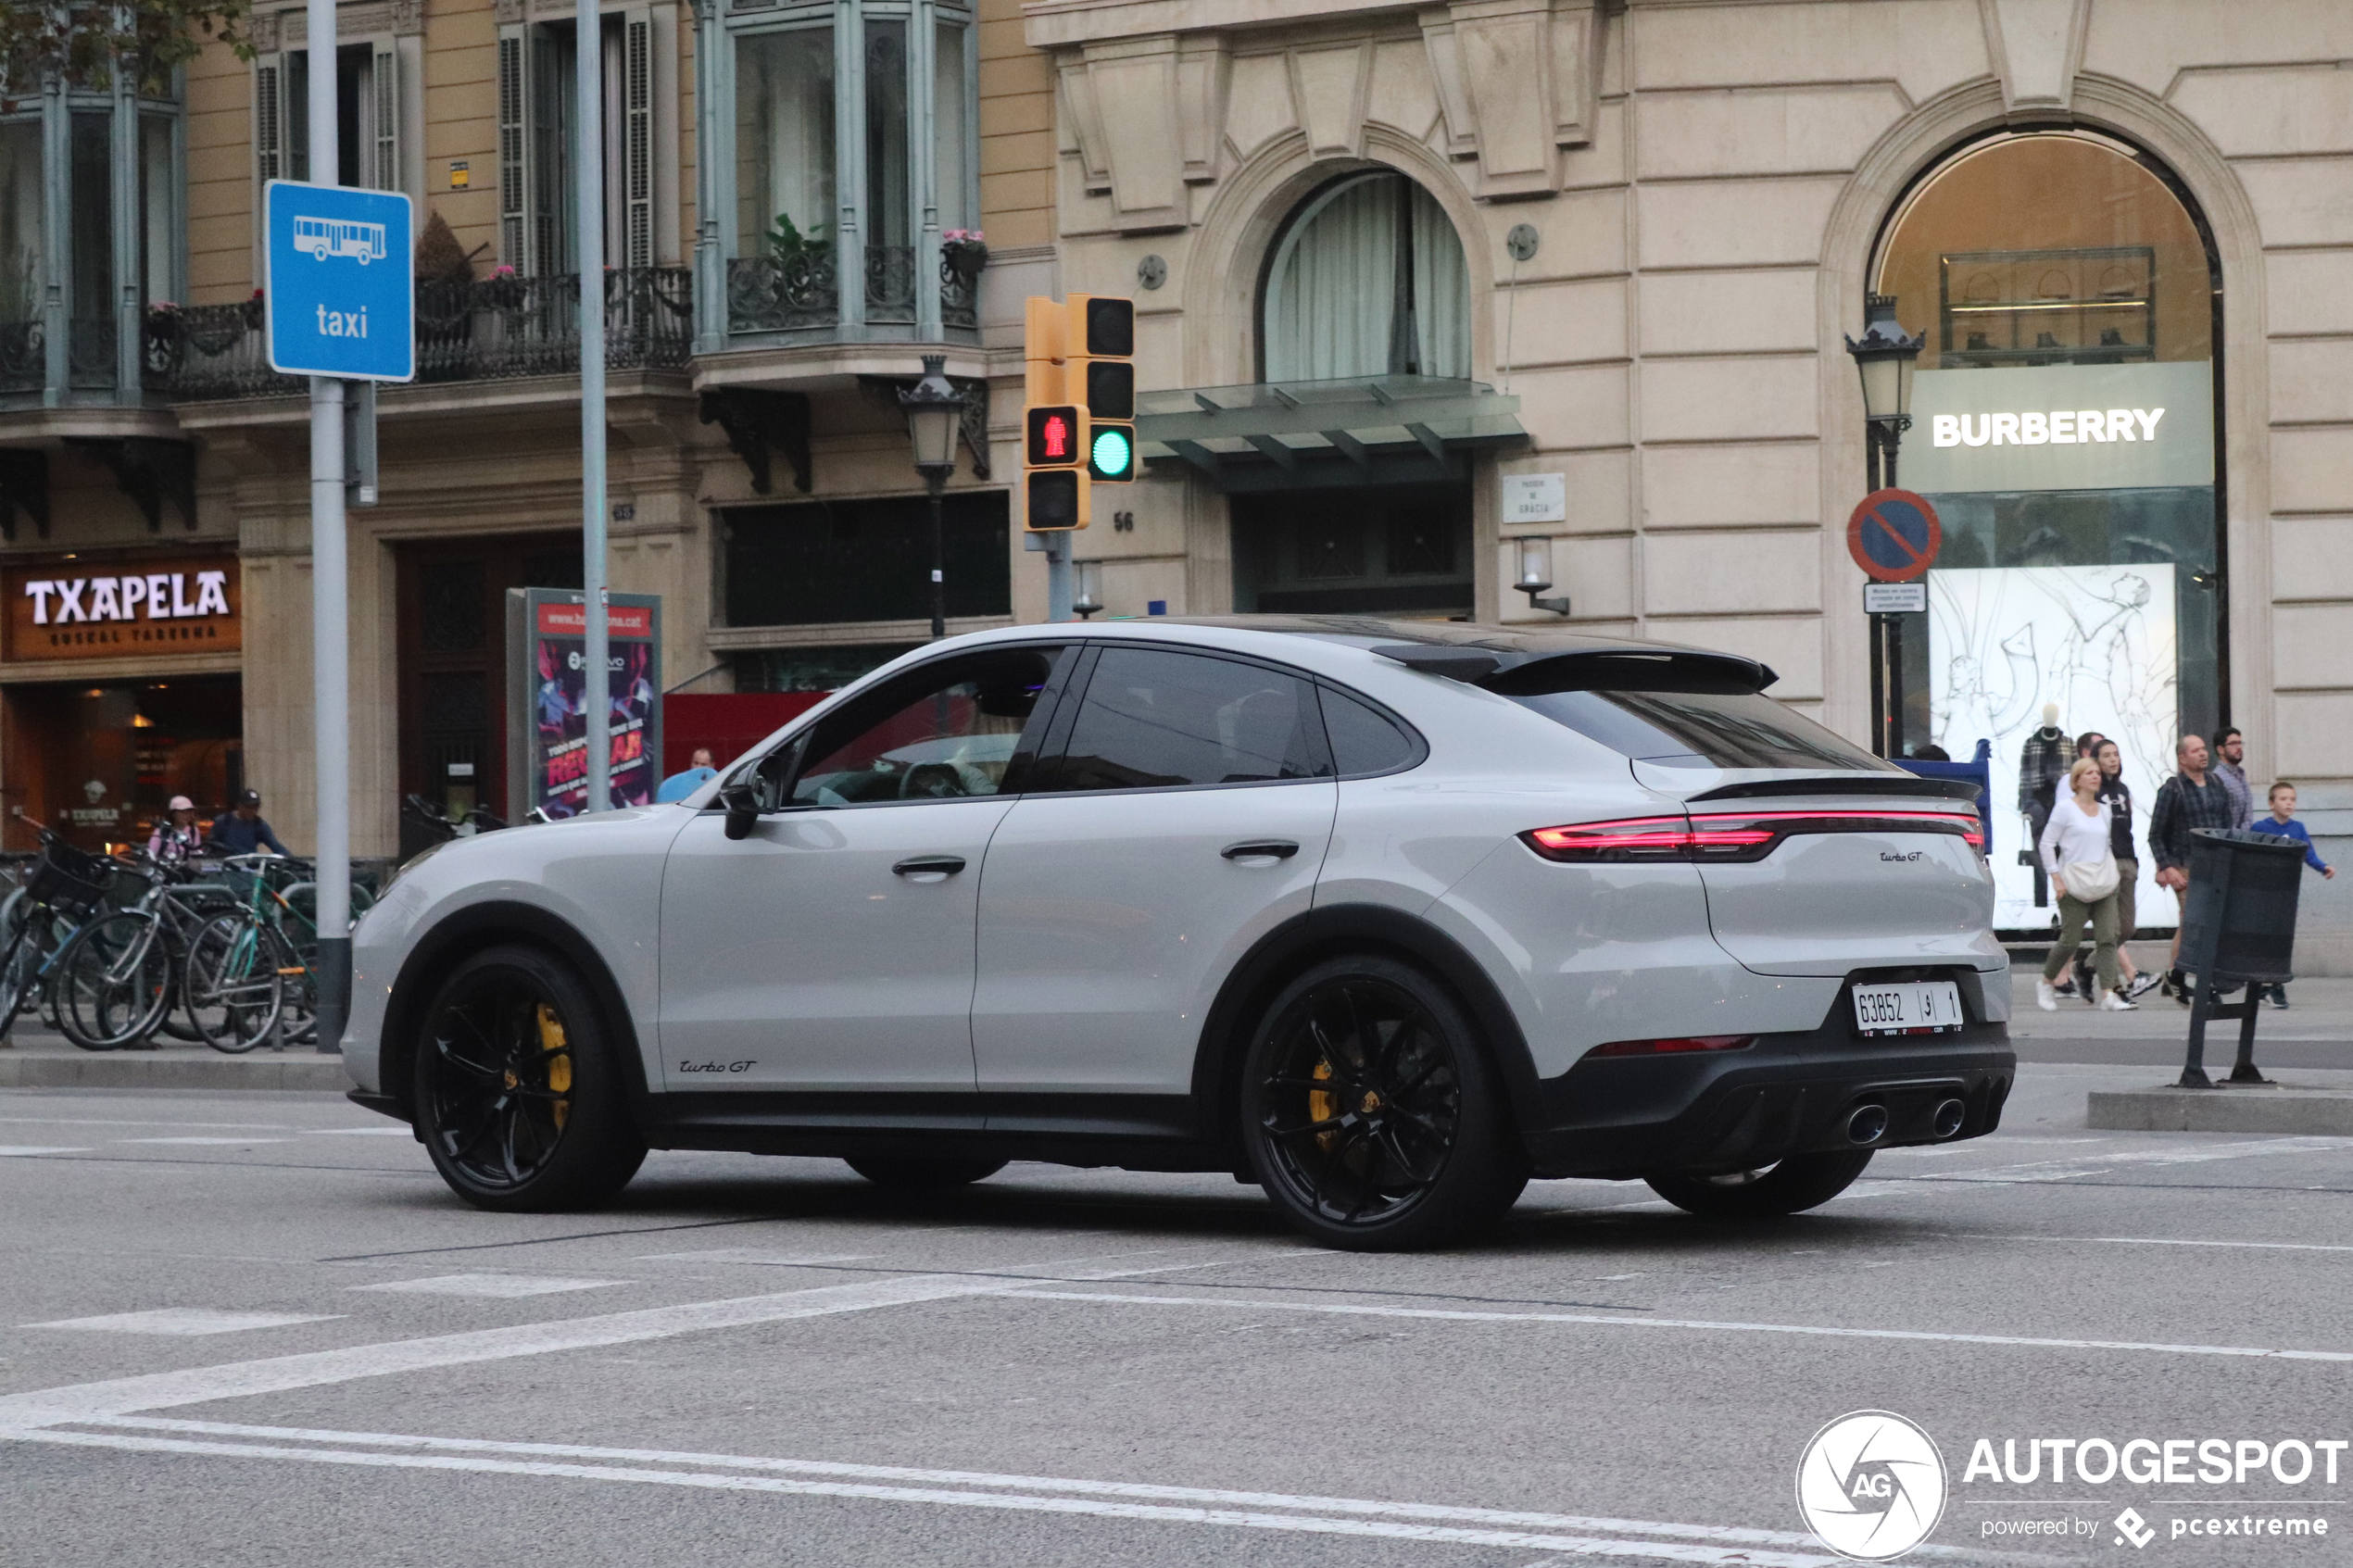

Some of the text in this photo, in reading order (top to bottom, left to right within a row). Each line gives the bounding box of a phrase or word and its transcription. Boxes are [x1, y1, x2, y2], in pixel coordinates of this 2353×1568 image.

[316, 303, 368, 339] taxi
[1932, 408, 2166, 447] BURBERRY
[1114, 510, 1134, 533] 56
[25, 570, 229, 625] TXAPELA
[1907, 851, 1922, 861] GT
[1859, 993, 1904, 1022] 63852
[729, 1060, 758, 1073] GT
